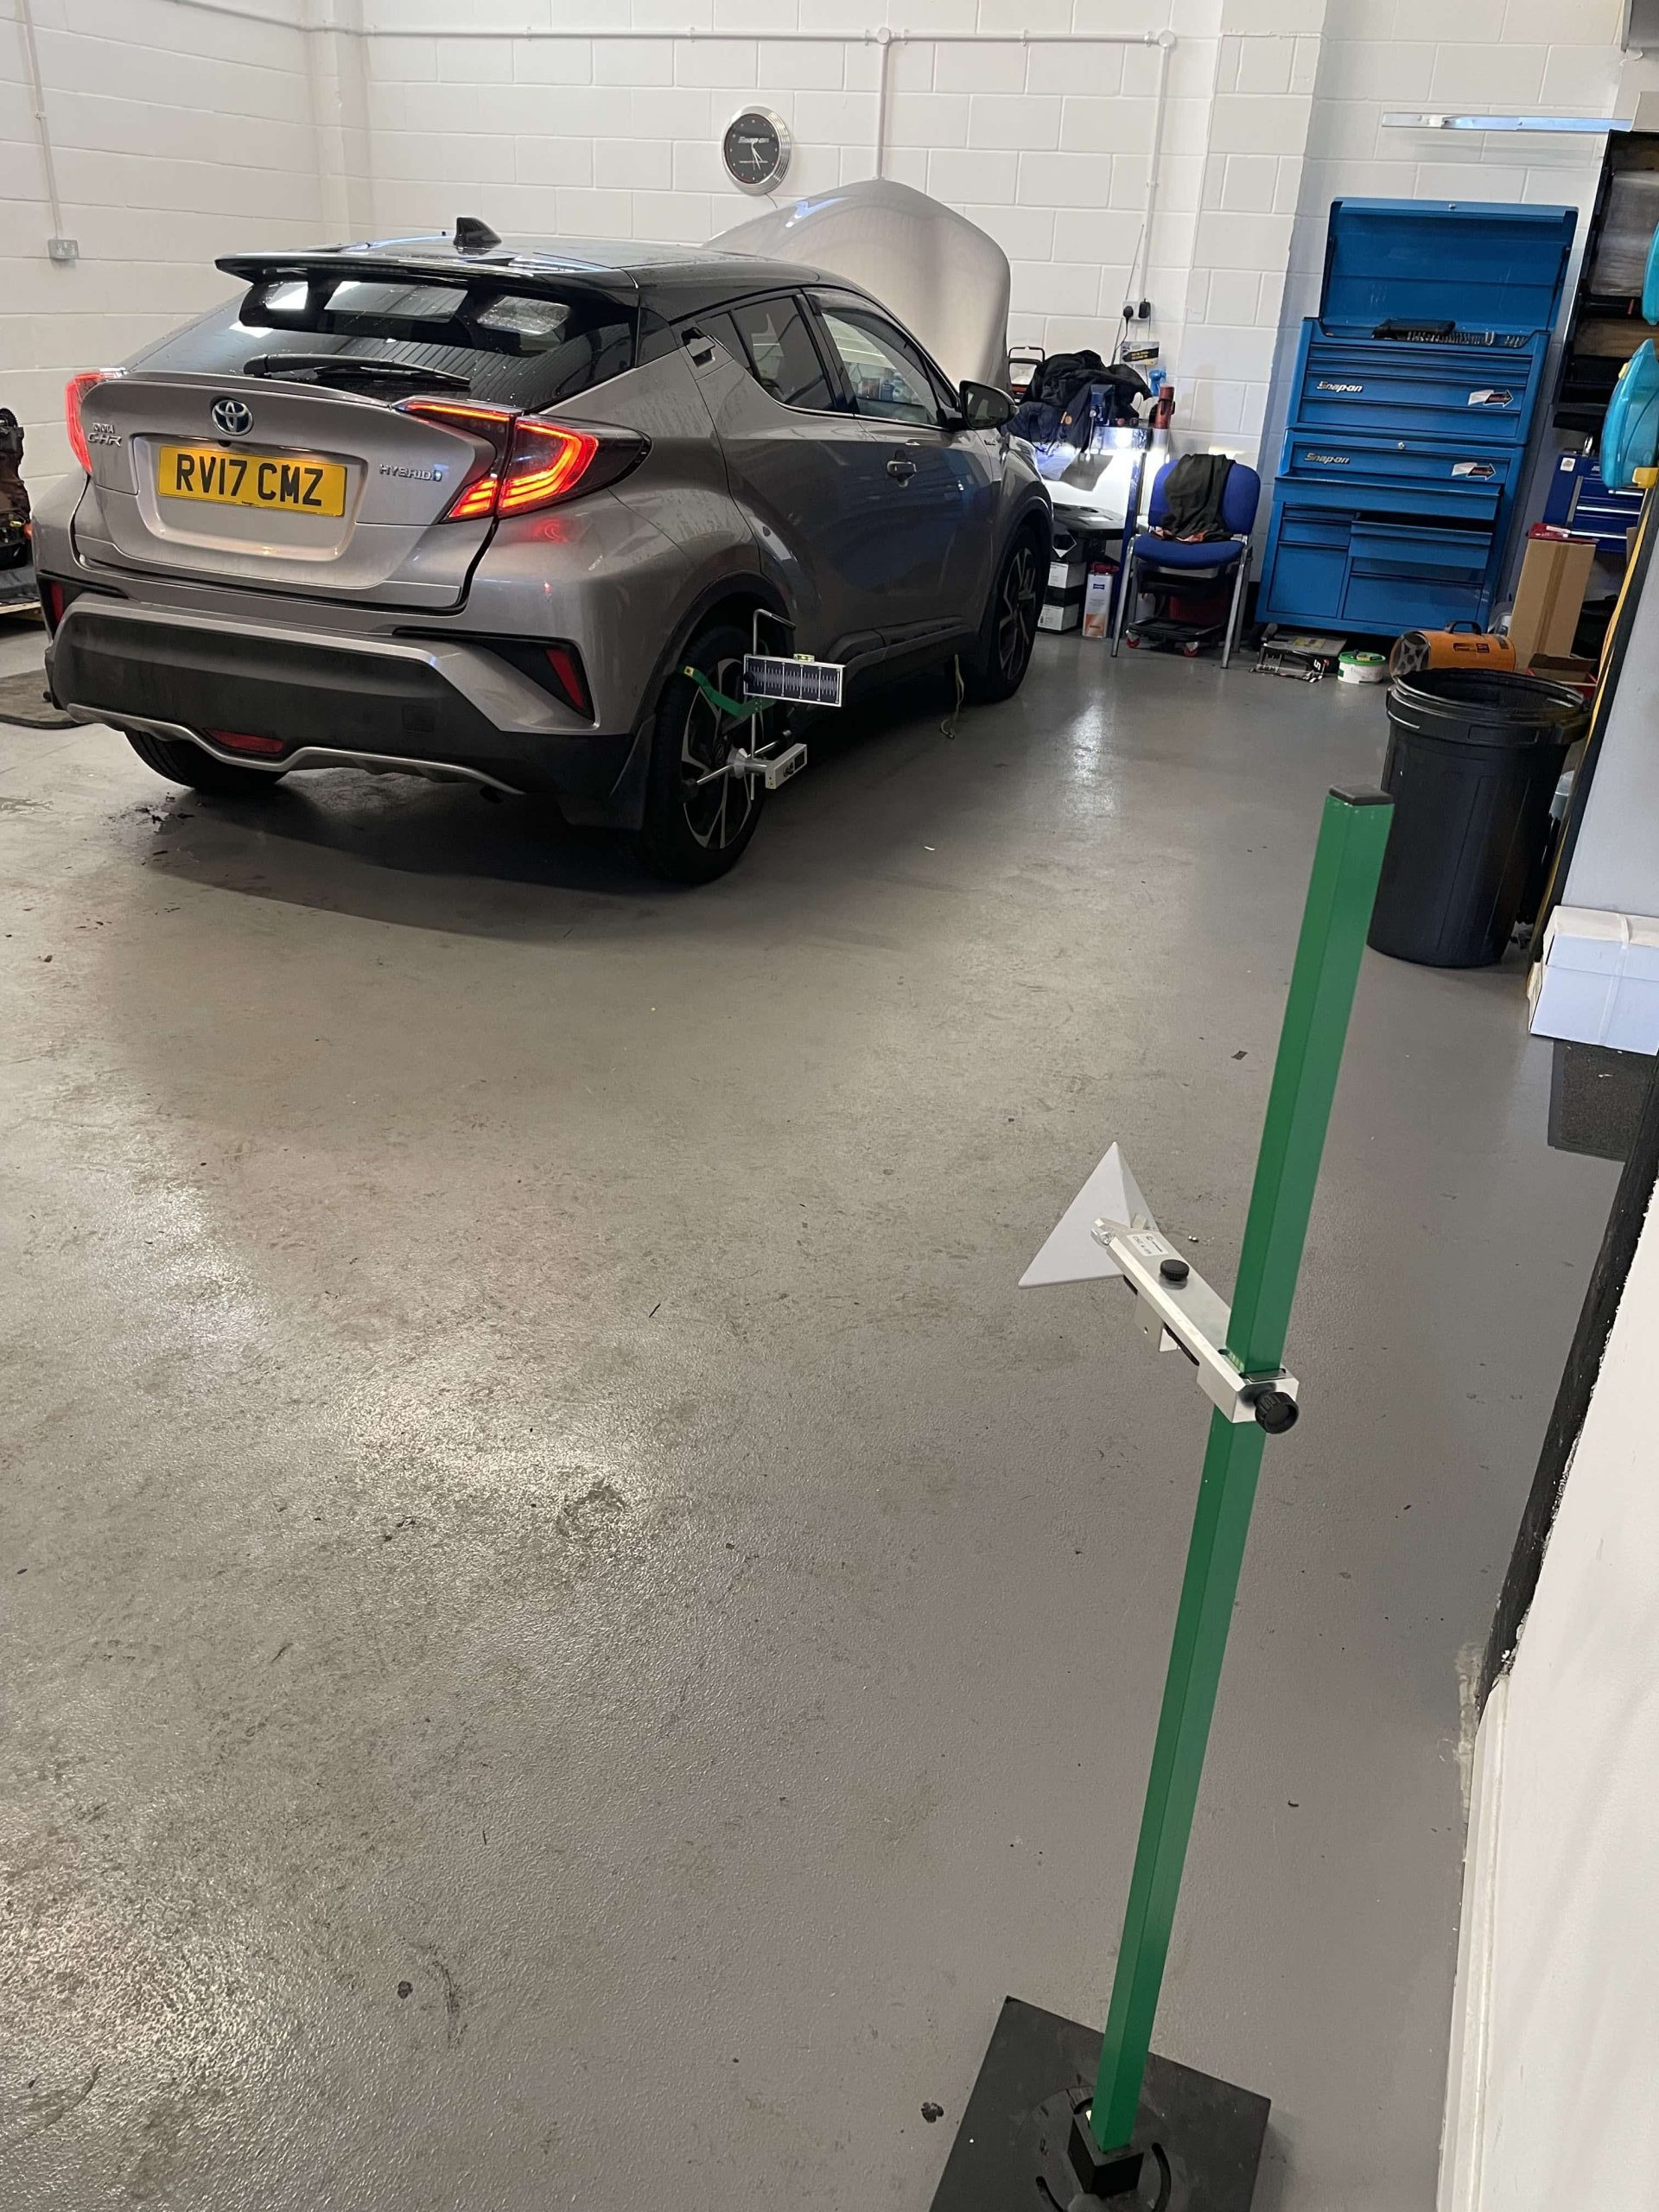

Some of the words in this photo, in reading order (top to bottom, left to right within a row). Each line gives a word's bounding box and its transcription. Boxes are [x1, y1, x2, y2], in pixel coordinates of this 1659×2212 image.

[1316, 380, 1363, 393] Snap-on
[87, 432, 122, 447] C-HR
[1304, 452, 1351, 465] Snap-on
[176, 453, 248, 497] RV17
[257, 462, 324, 507] CMZ
[379, 463, 432, 482] HYBRID
